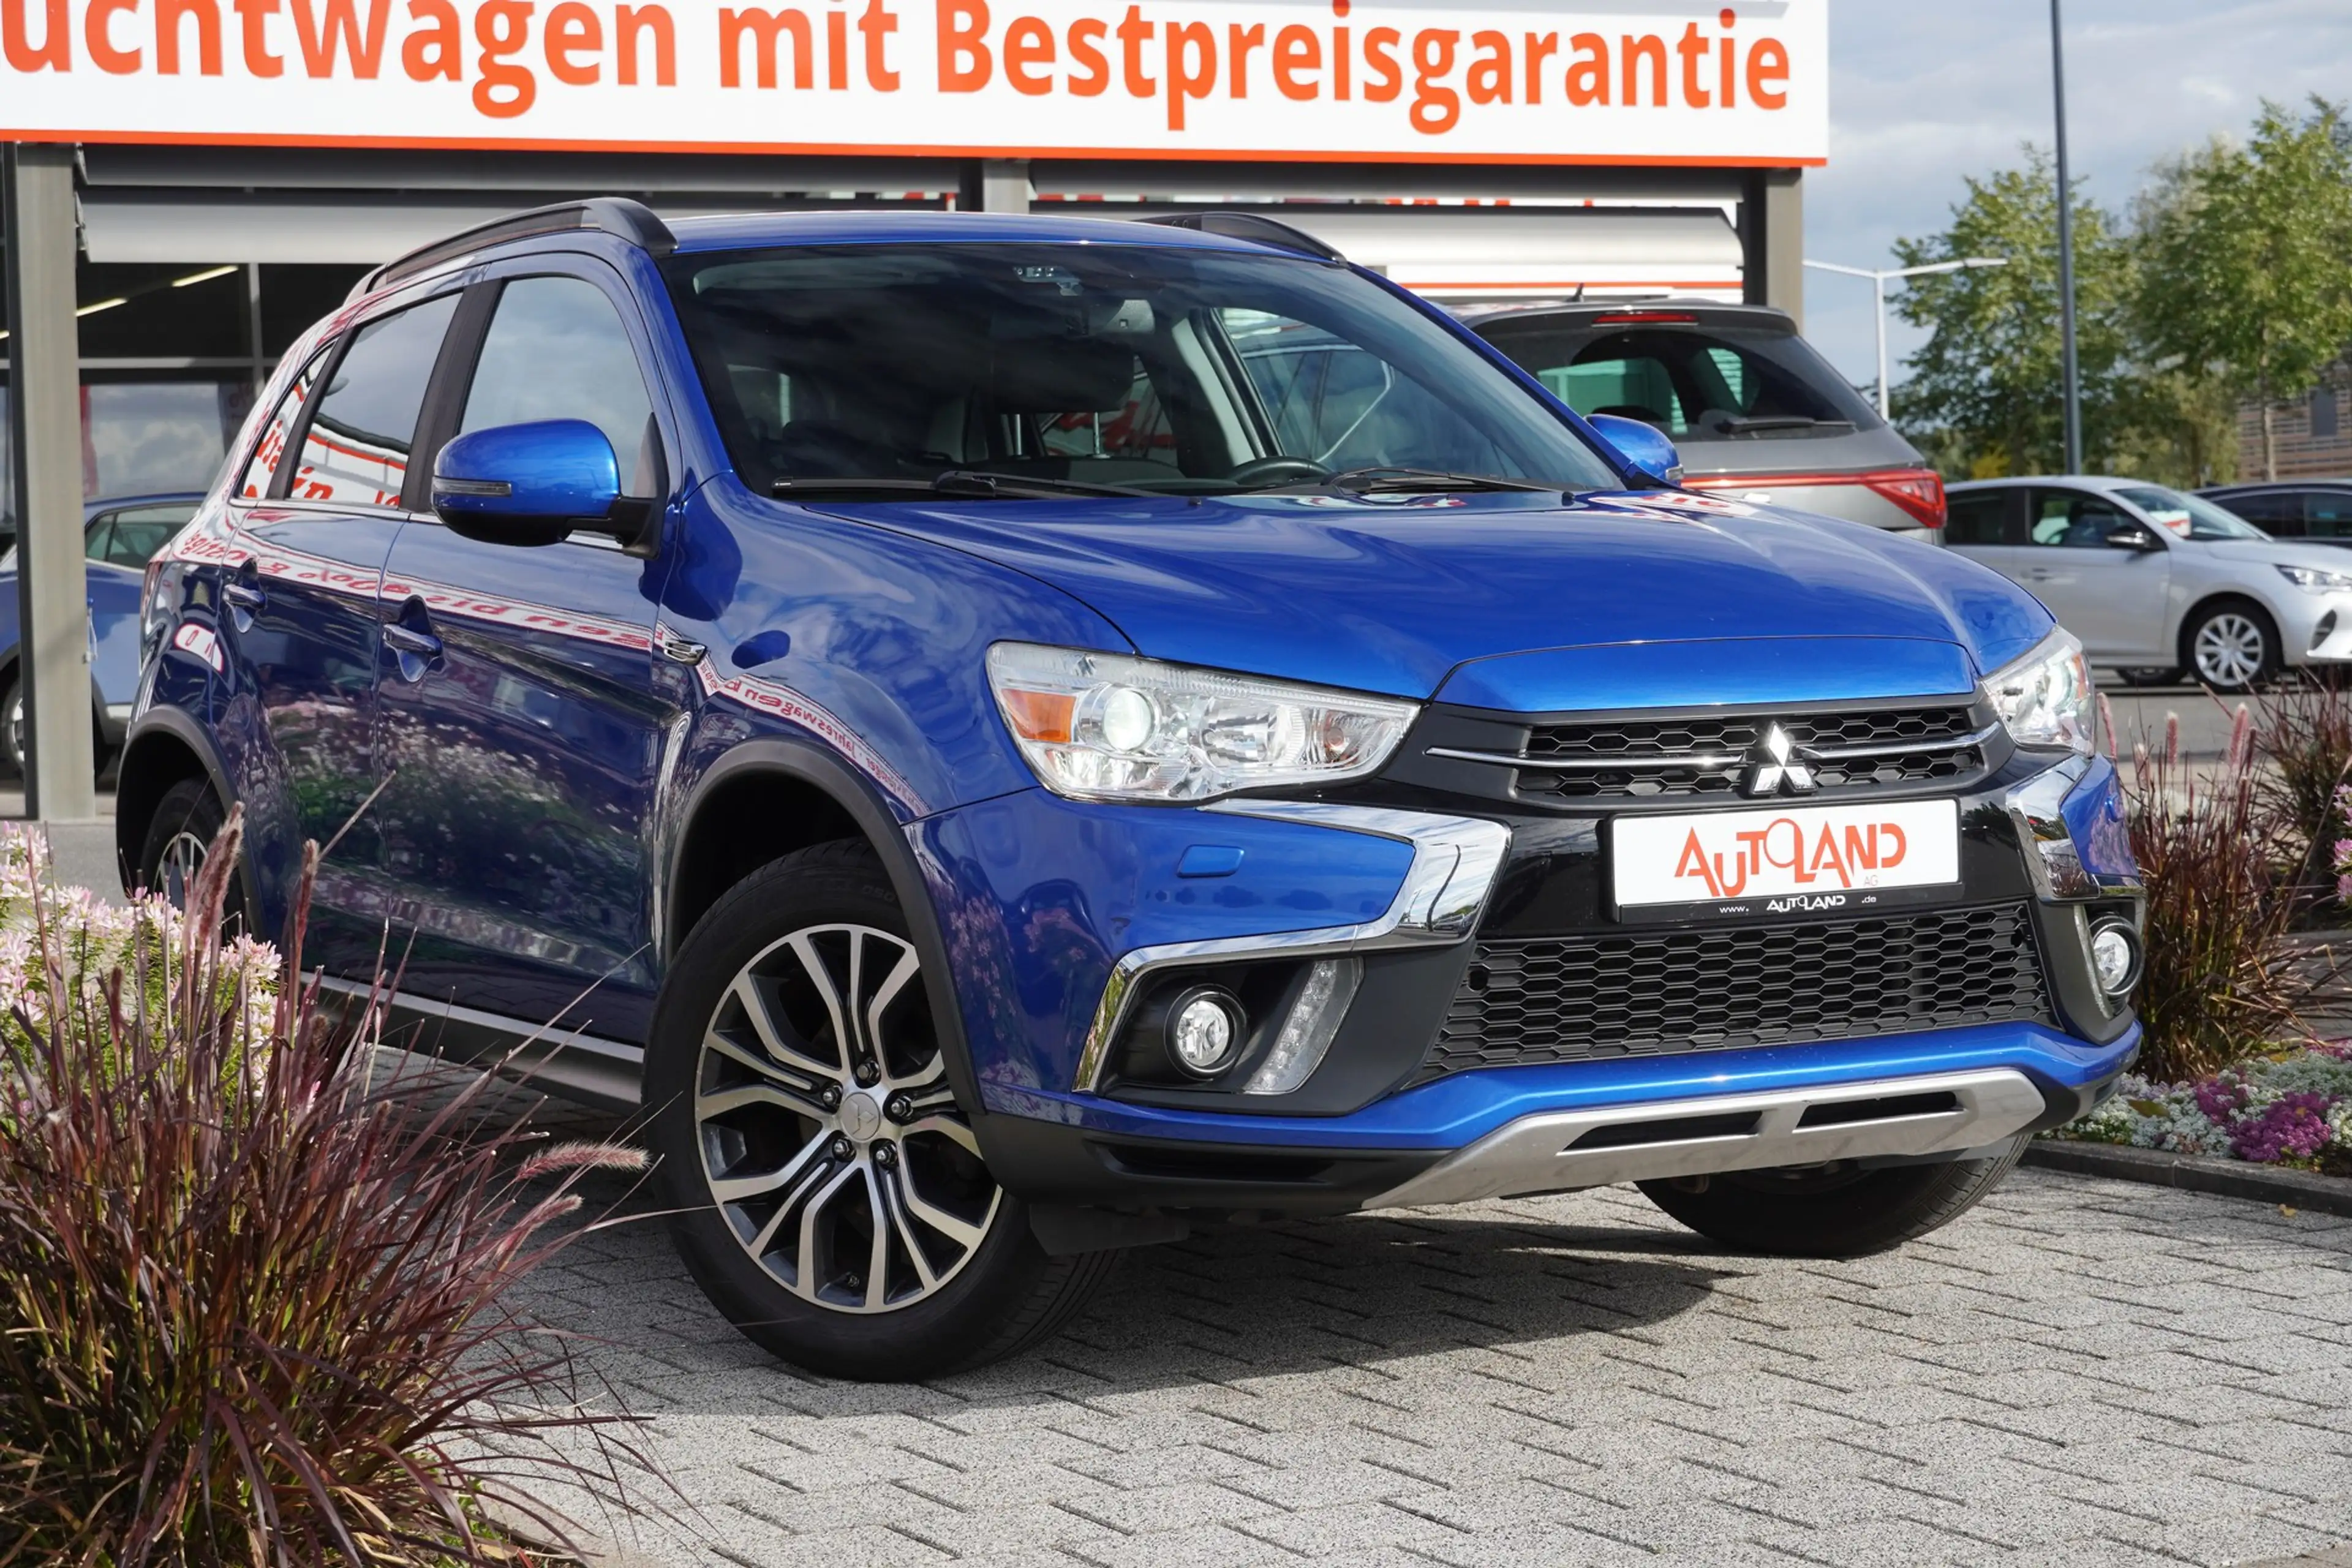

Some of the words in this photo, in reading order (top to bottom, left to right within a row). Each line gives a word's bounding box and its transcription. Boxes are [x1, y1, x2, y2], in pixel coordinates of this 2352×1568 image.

[718, 0, 900, 92] mit
[937, 0, 1790, 135] Bestpreisgarantie
[1863, 876, 1879, 887] AG
[1719, 905, 1749, 914] www.
[1861, 895, 1877, 904] .de
